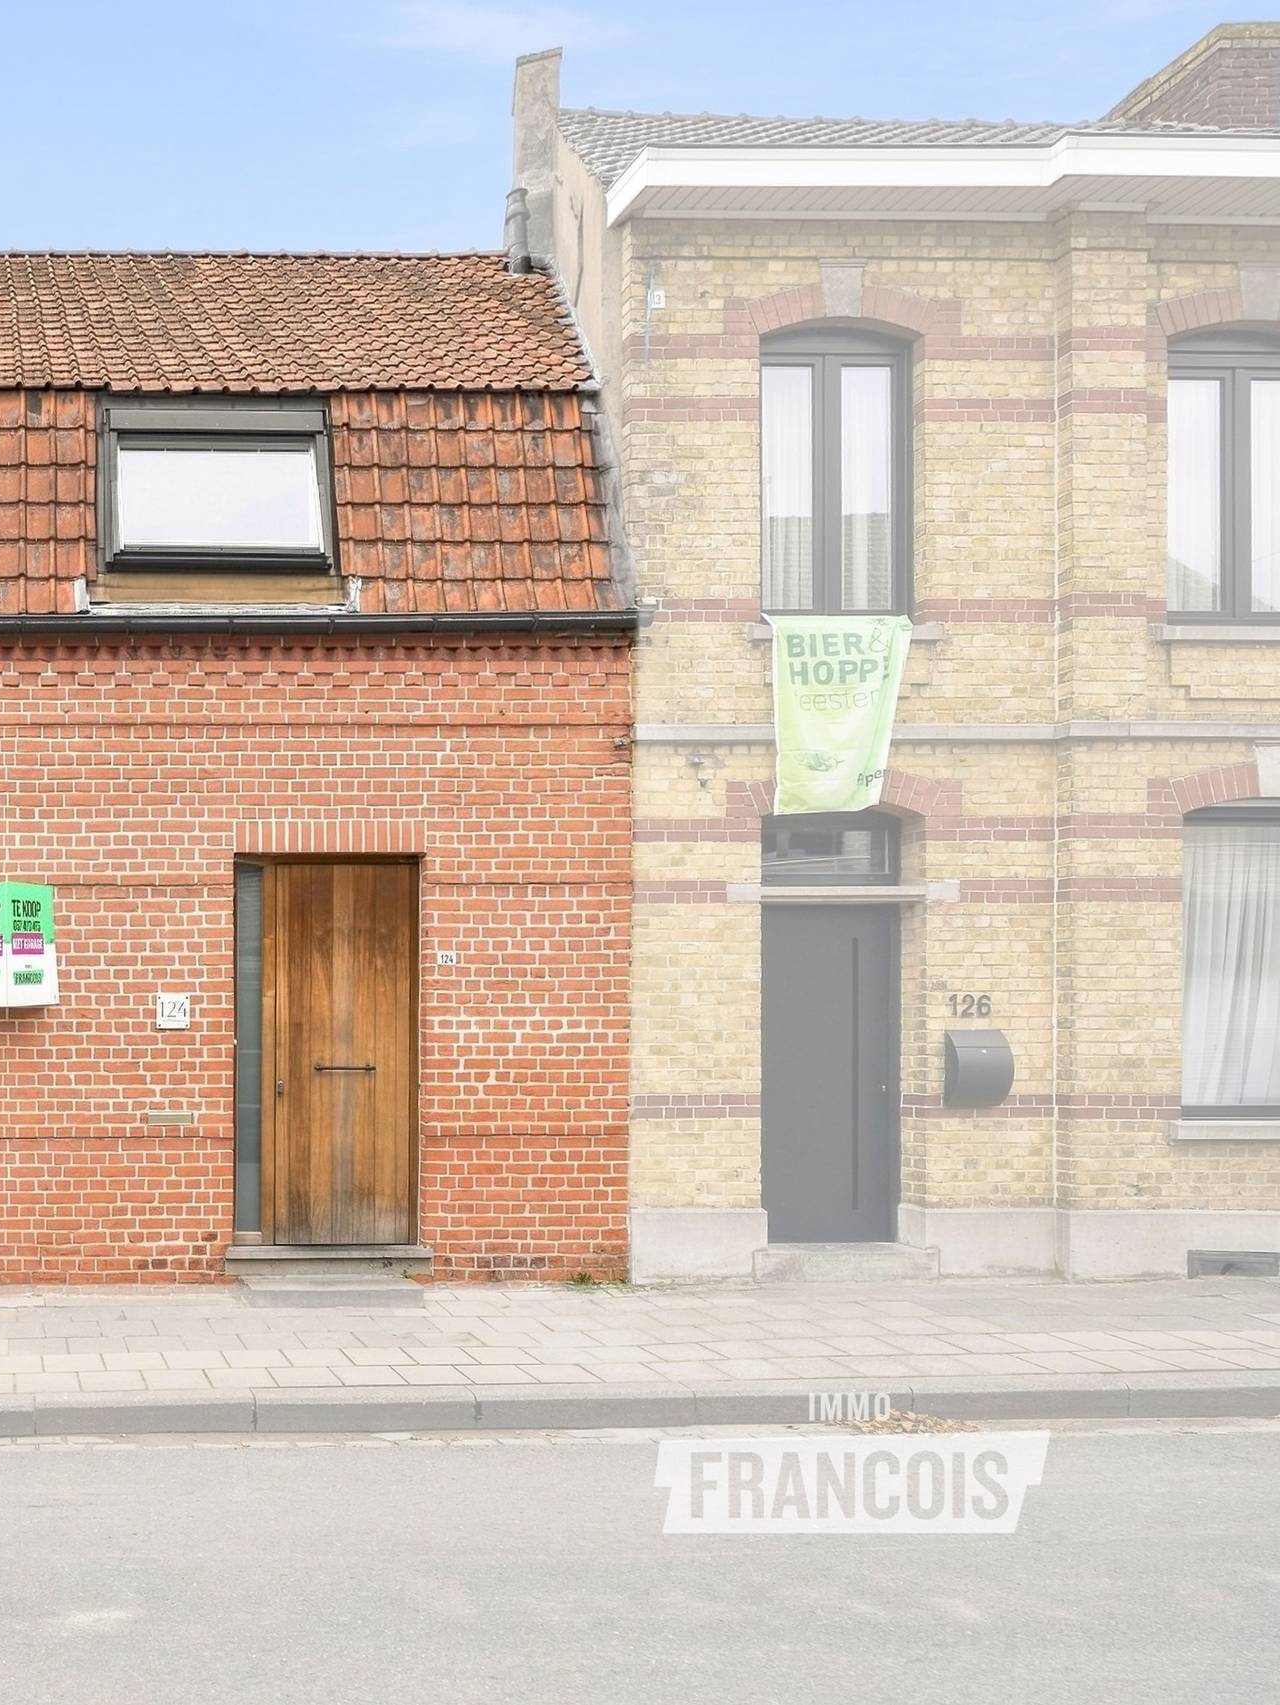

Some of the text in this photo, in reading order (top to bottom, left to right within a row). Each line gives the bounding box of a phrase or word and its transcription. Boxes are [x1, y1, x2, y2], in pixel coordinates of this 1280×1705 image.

[786, 627, 889, 658] BIER &
[11, 899, 41, 918] TE KOOP
[441, 954, 454, 964] 124
[161, 1001, 187, 1018] 124
[948, 993, 992, 1017] 126
